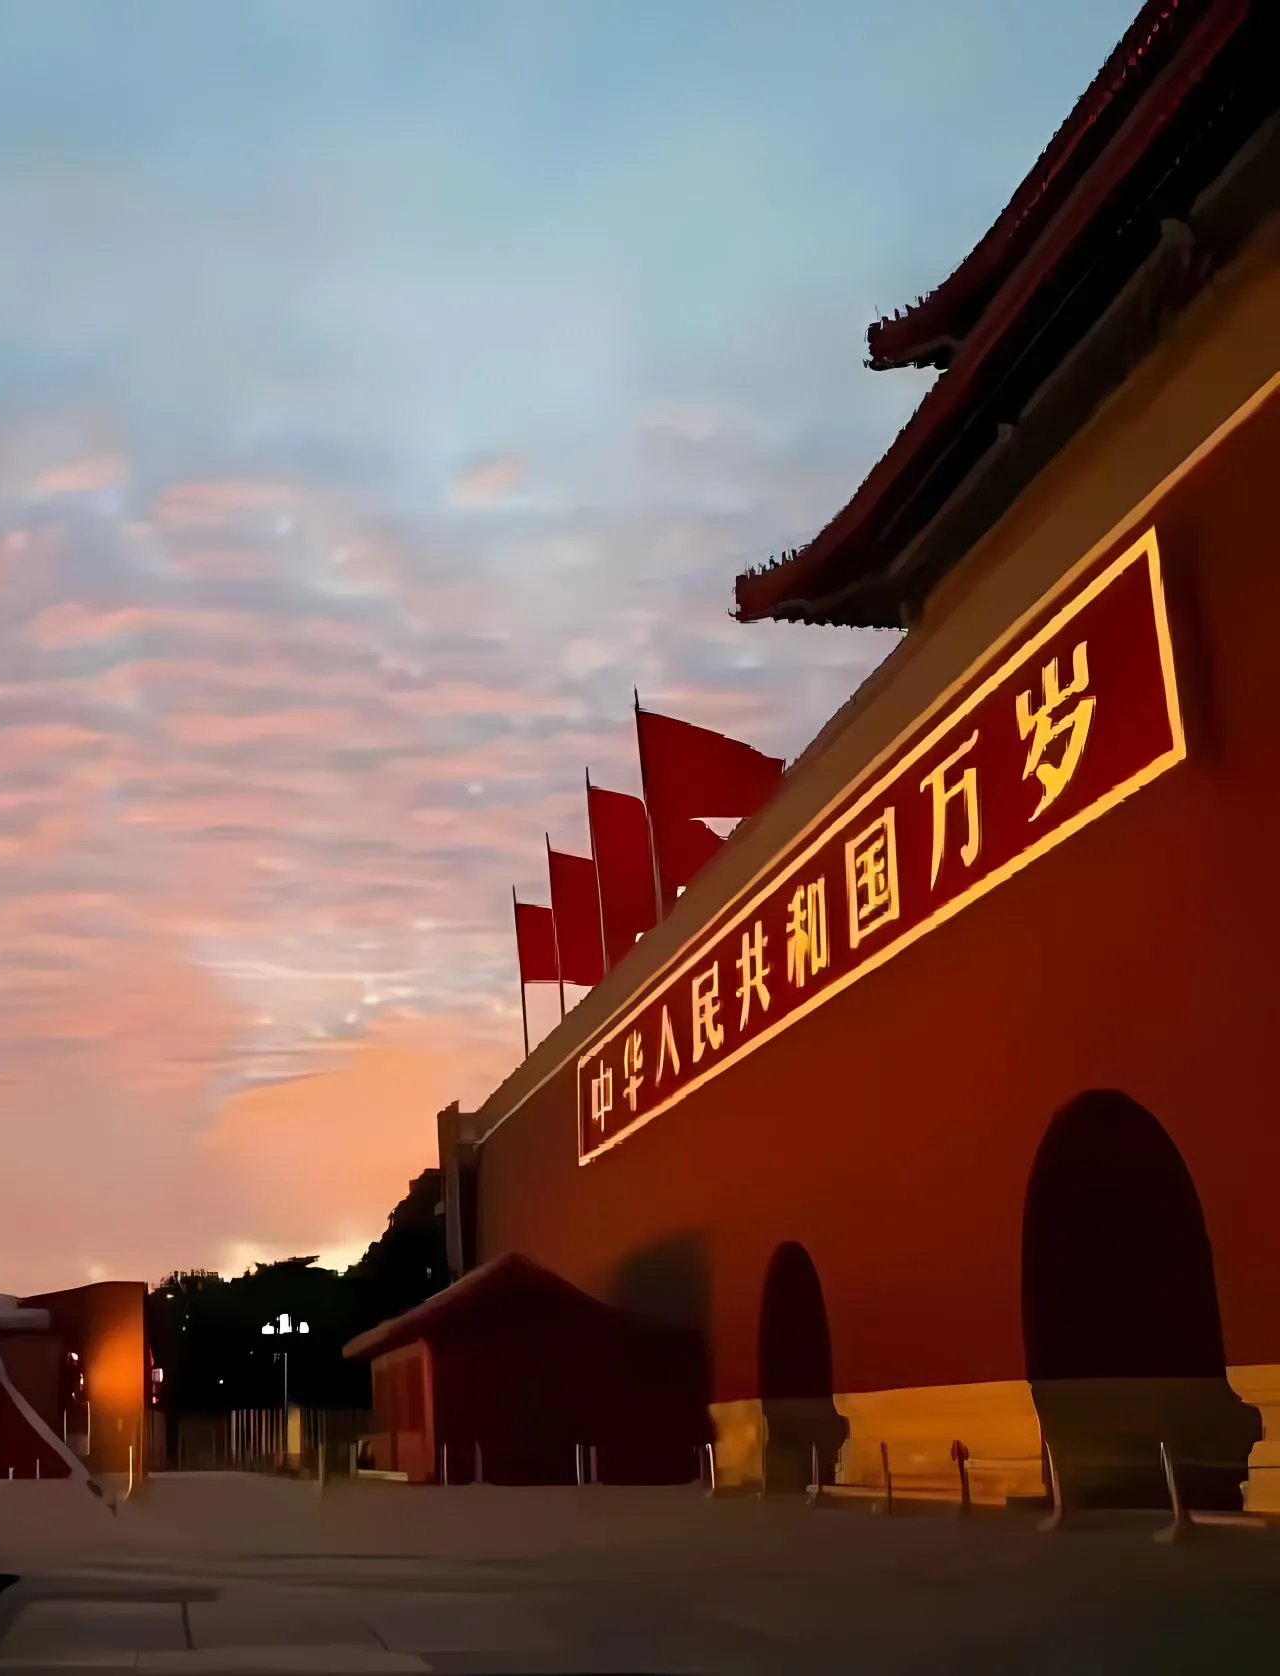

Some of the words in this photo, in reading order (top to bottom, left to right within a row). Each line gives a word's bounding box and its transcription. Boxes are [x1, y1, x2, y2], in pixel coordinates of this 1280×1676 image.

[590, 640, 1097, 1132] 中华人民共和国万岁
